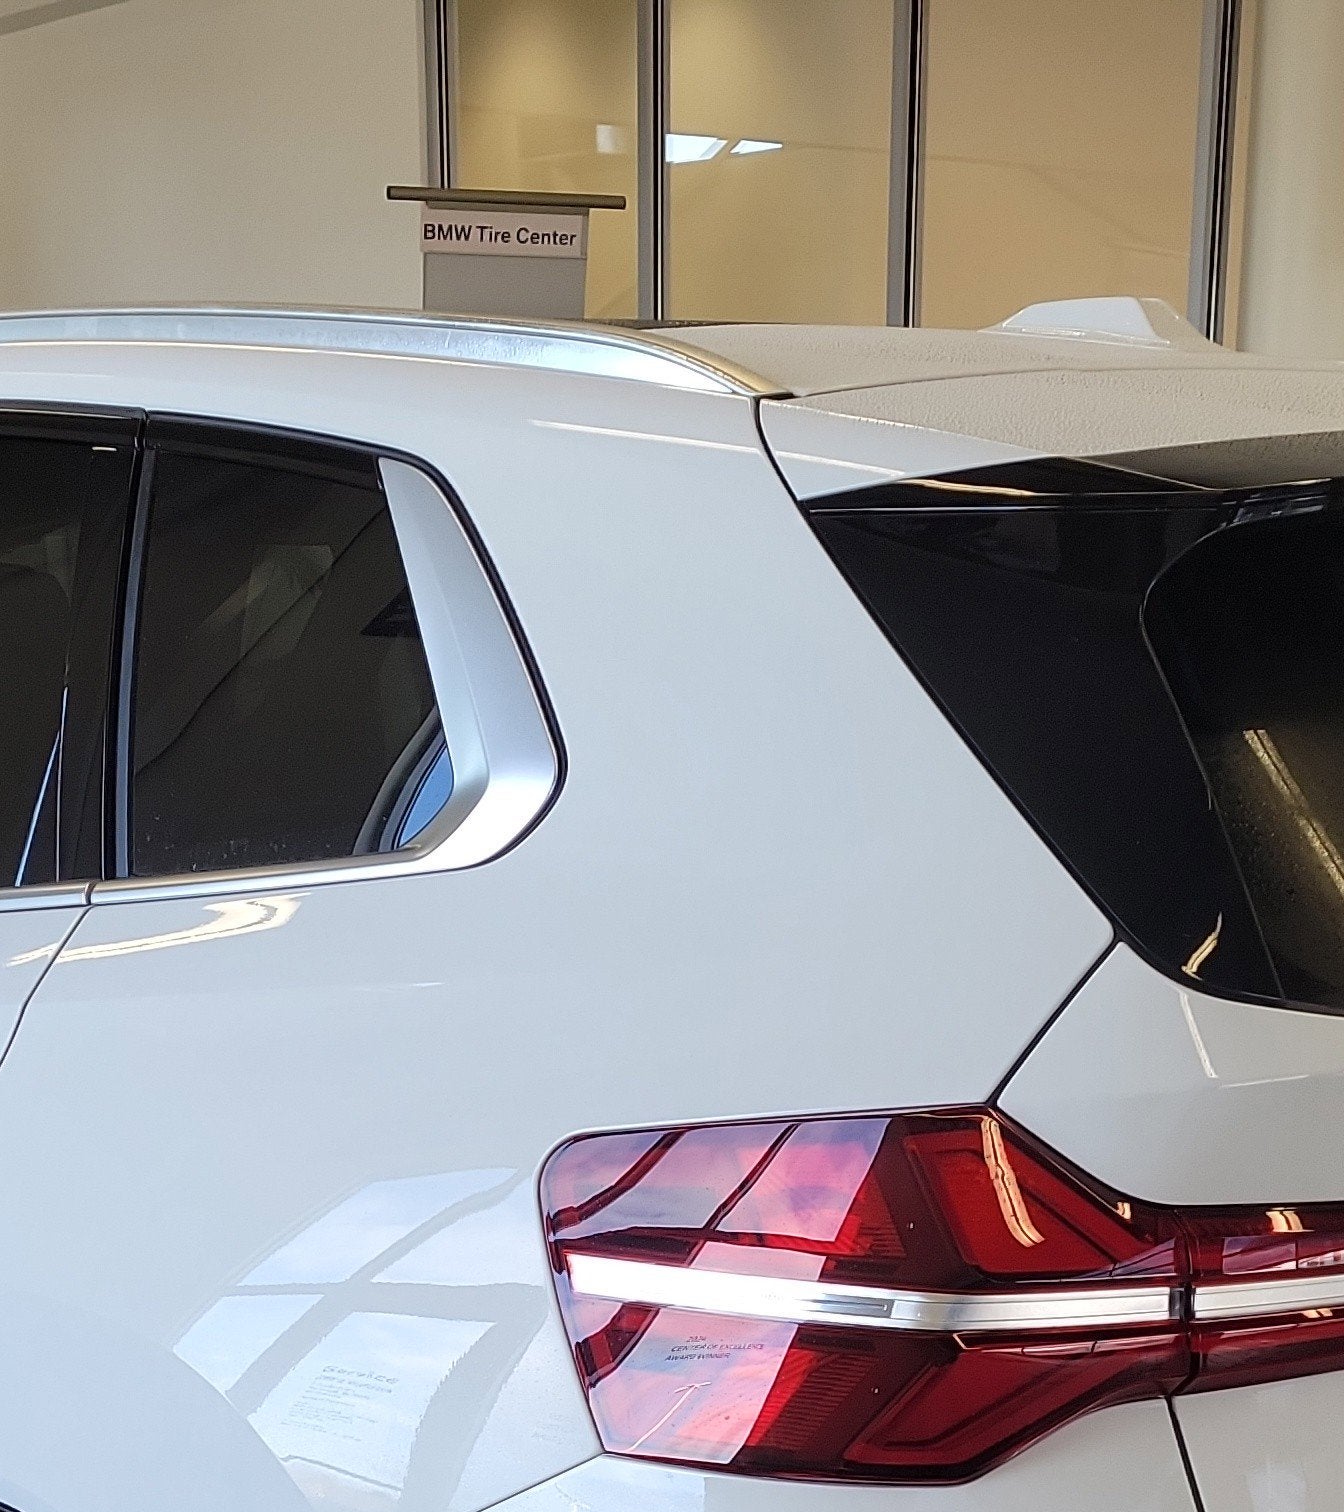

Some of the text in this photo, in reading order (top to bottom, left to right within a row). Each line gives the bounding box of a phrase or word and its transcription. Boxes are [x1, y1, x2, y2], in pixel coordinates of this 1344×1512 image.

[423, 223, 577, 246] BMW Tire Center
